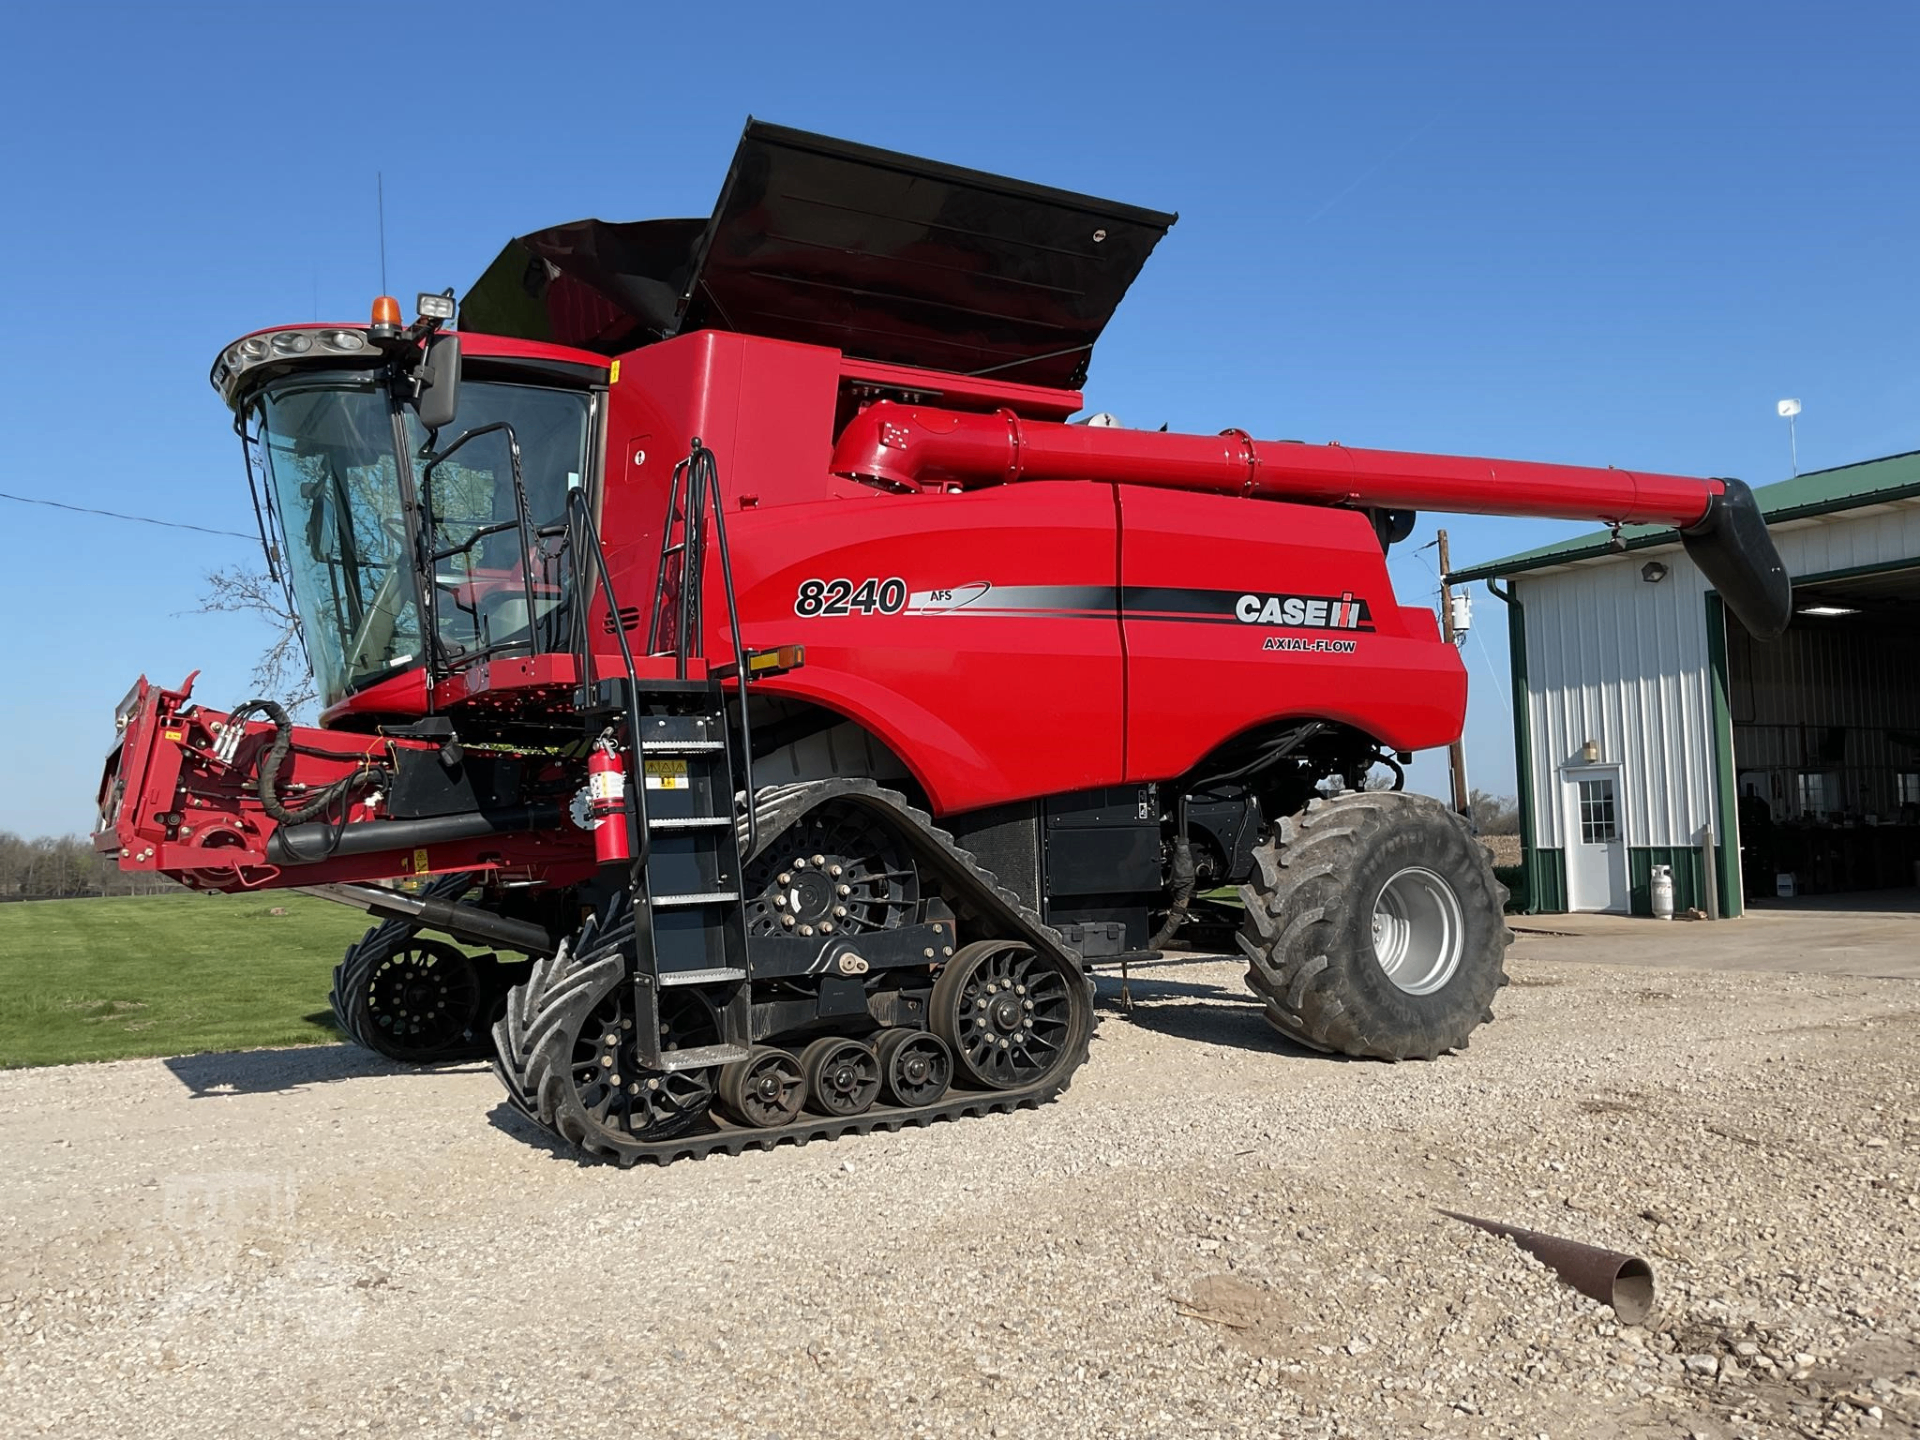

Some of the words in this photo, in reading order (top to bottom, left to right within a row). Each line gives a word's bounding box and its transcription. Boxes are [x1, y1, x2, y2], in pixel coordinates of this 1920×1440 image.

[794, 577, 906, 618] 8240
[930, 590, 952, 602] AFS
[1262, 637, 1357, 653] AXIAL-FLOW
